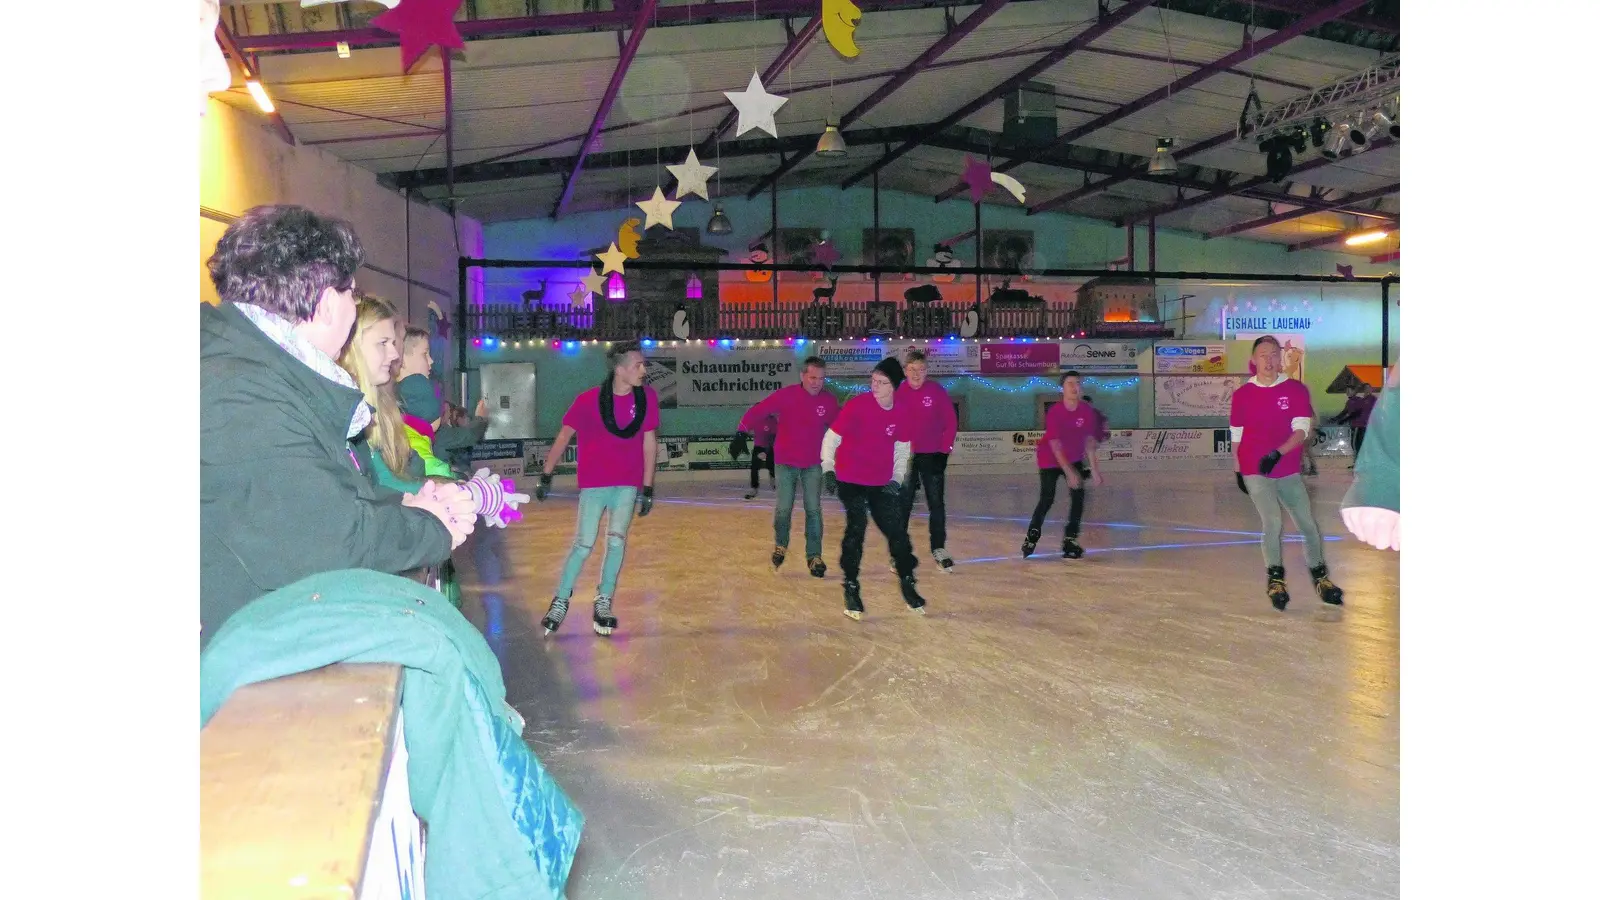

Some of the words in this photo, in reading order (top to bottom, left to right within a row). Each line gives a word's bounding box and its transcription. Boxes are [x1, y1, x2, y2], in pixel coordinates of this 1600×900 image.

[1226, 317, 1267, 330] EISHALLE
[1272, 317, 1311, 330] LAUENAU
[995, 353, 1029, 361] Sparkasse
[682, 360, 792, 376] Schaumburger
[1018, 361, 1057, 369] Schaumburg
[692, 378, 782, 392] Nachrichten
